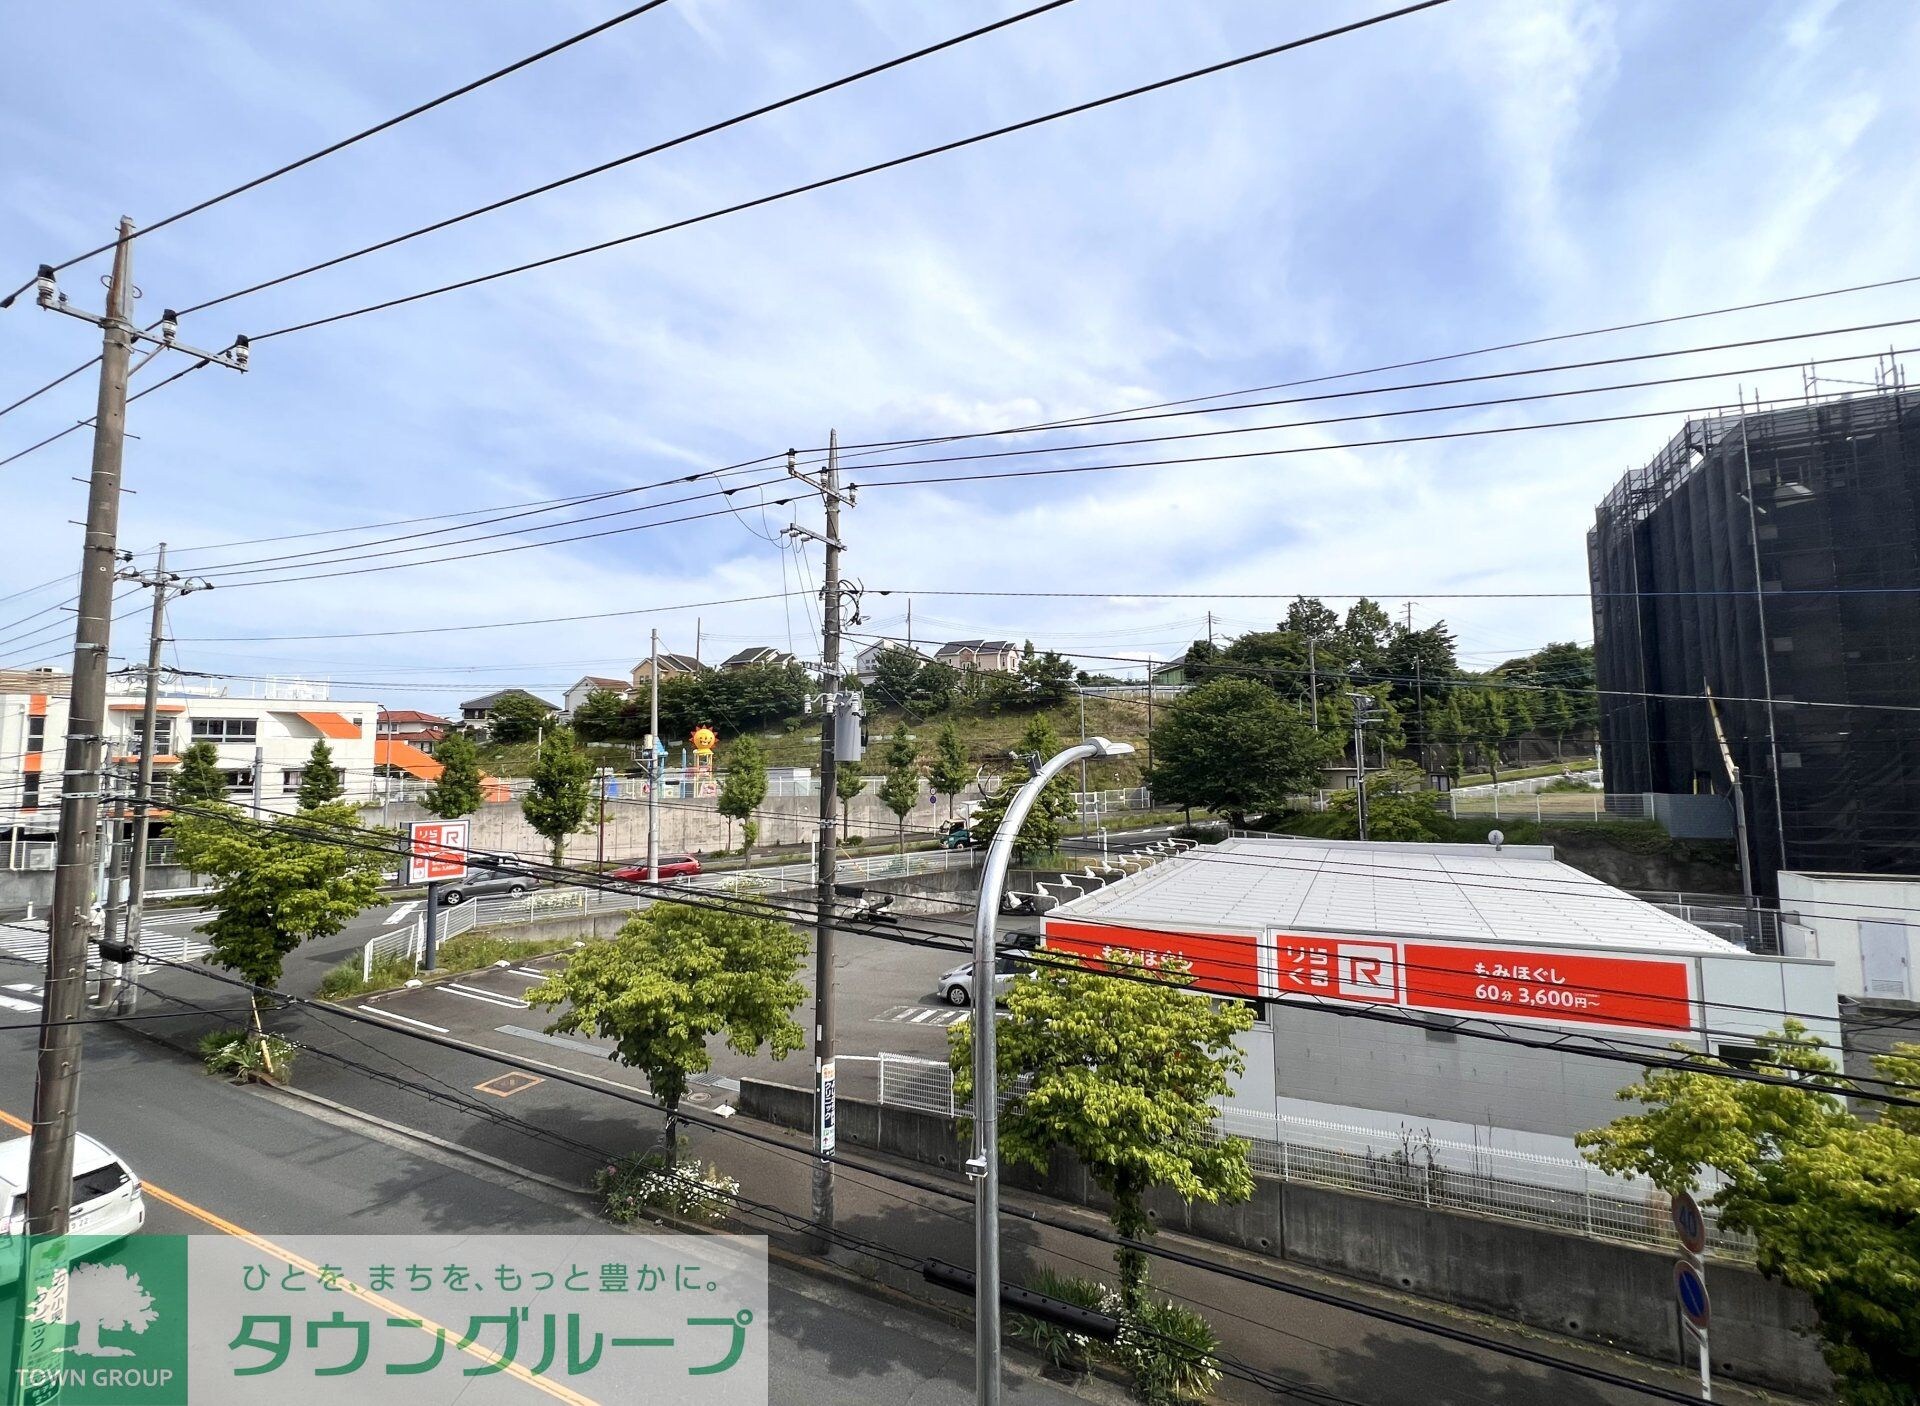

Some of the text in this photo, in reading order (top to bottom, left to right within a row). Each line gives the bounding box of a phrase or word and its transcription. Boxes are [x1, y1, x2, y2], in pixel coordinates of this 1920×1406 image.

[1287, 945, 1328, 965] りら
[1288, 967, 1329, 987] くる
[1350, 956, 1381, 986] R
[1474, 962, 1566, 984] もみほぐし
[1475, 984, 1514, 1001] 60分
